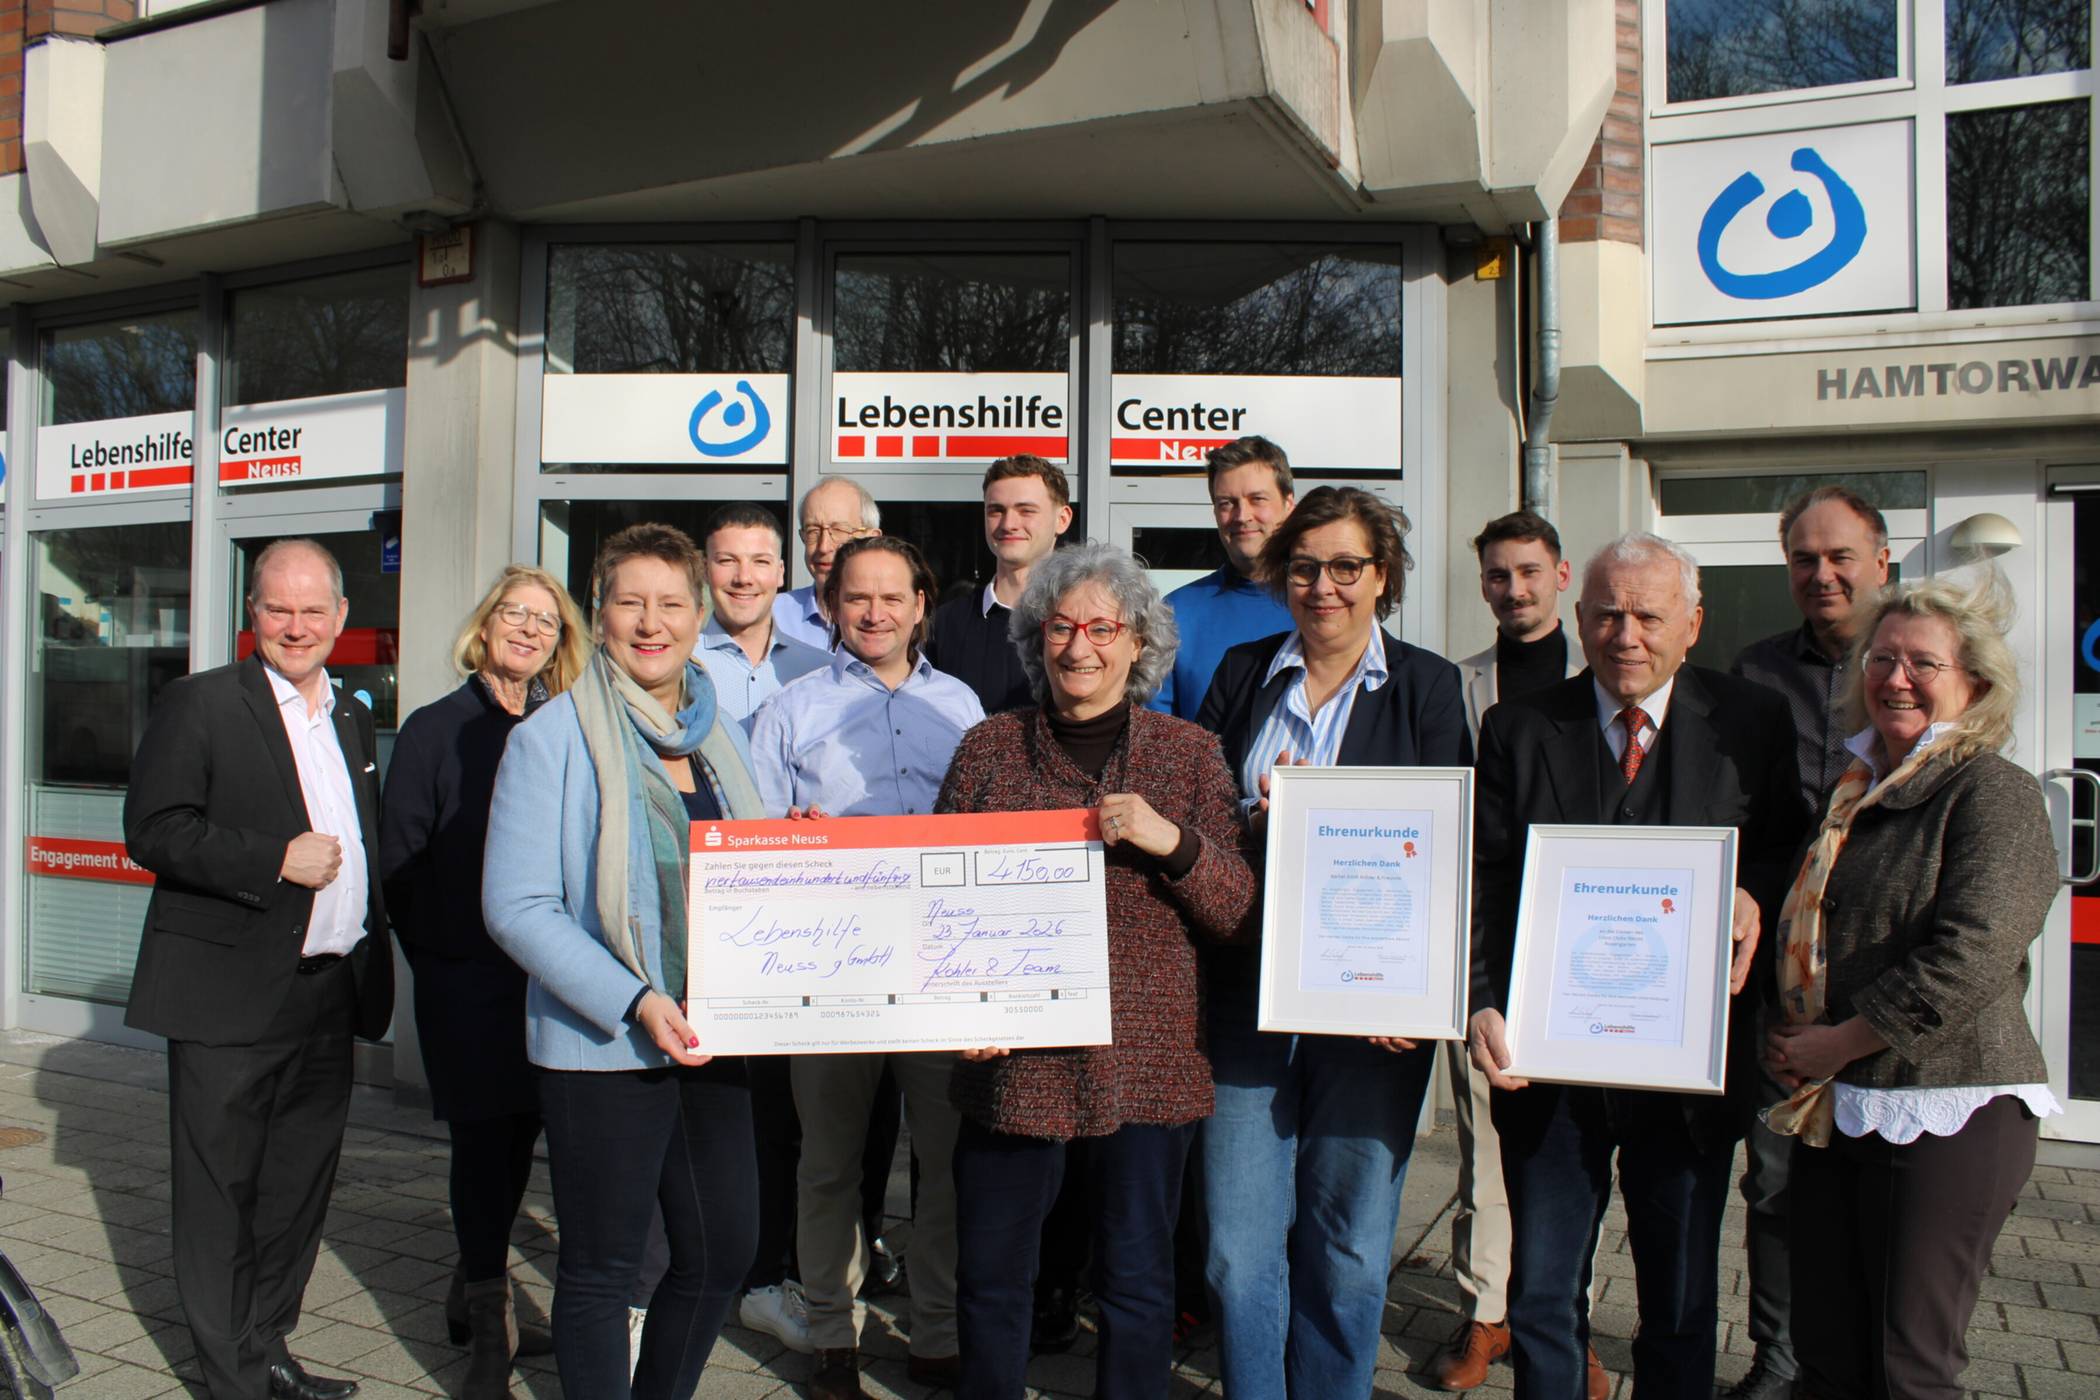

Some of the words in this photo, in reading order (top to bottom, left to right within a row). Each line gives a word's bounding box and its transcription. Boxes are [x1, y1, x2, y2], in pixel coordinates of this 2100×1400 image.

[838, 395, 1063, 429] Lebenshilfe
[1117, 398, 1246, 431] Center
[71, 431, 193, 469] Lebenshilfe
[224, 427, 302, 456] Center
[248, 460, 300, 479] Neuss
[1318, 825, 1420, 840] Ehrenurkunde
[727, 834, 789, 848] Sparkasse
[791, 833, 829, 845] Neuss
[31, 846, 118, 870] Engagement
[705, 862, 733, 870] Zahlen
[735, 861, 747, 869] Sie
[748, 862, 774, 871] gegen
[776, 860, 803, 868] diesen
[1333, 859, 1378, 867] Herzlichen
[1379, 860, 1400, 868] Dank
[934, 867, 951, 875] EUR
[1574, 882, 1678, 896] Ehrenurkunde
[928, 898, 975, 924] Neuss
[1587, 914, 1634, 922] Herzlichen
[1635, 915, 1658, 923] Dank
[720, 906, 861, 949] Lebenshilfe
[1019, 919, 1066, 937] 2026
[922, 943, 943, 951] Datum
[761, 951, 817, 976] Neuss
[1004, 1005, 1043, 1014] 30550000
